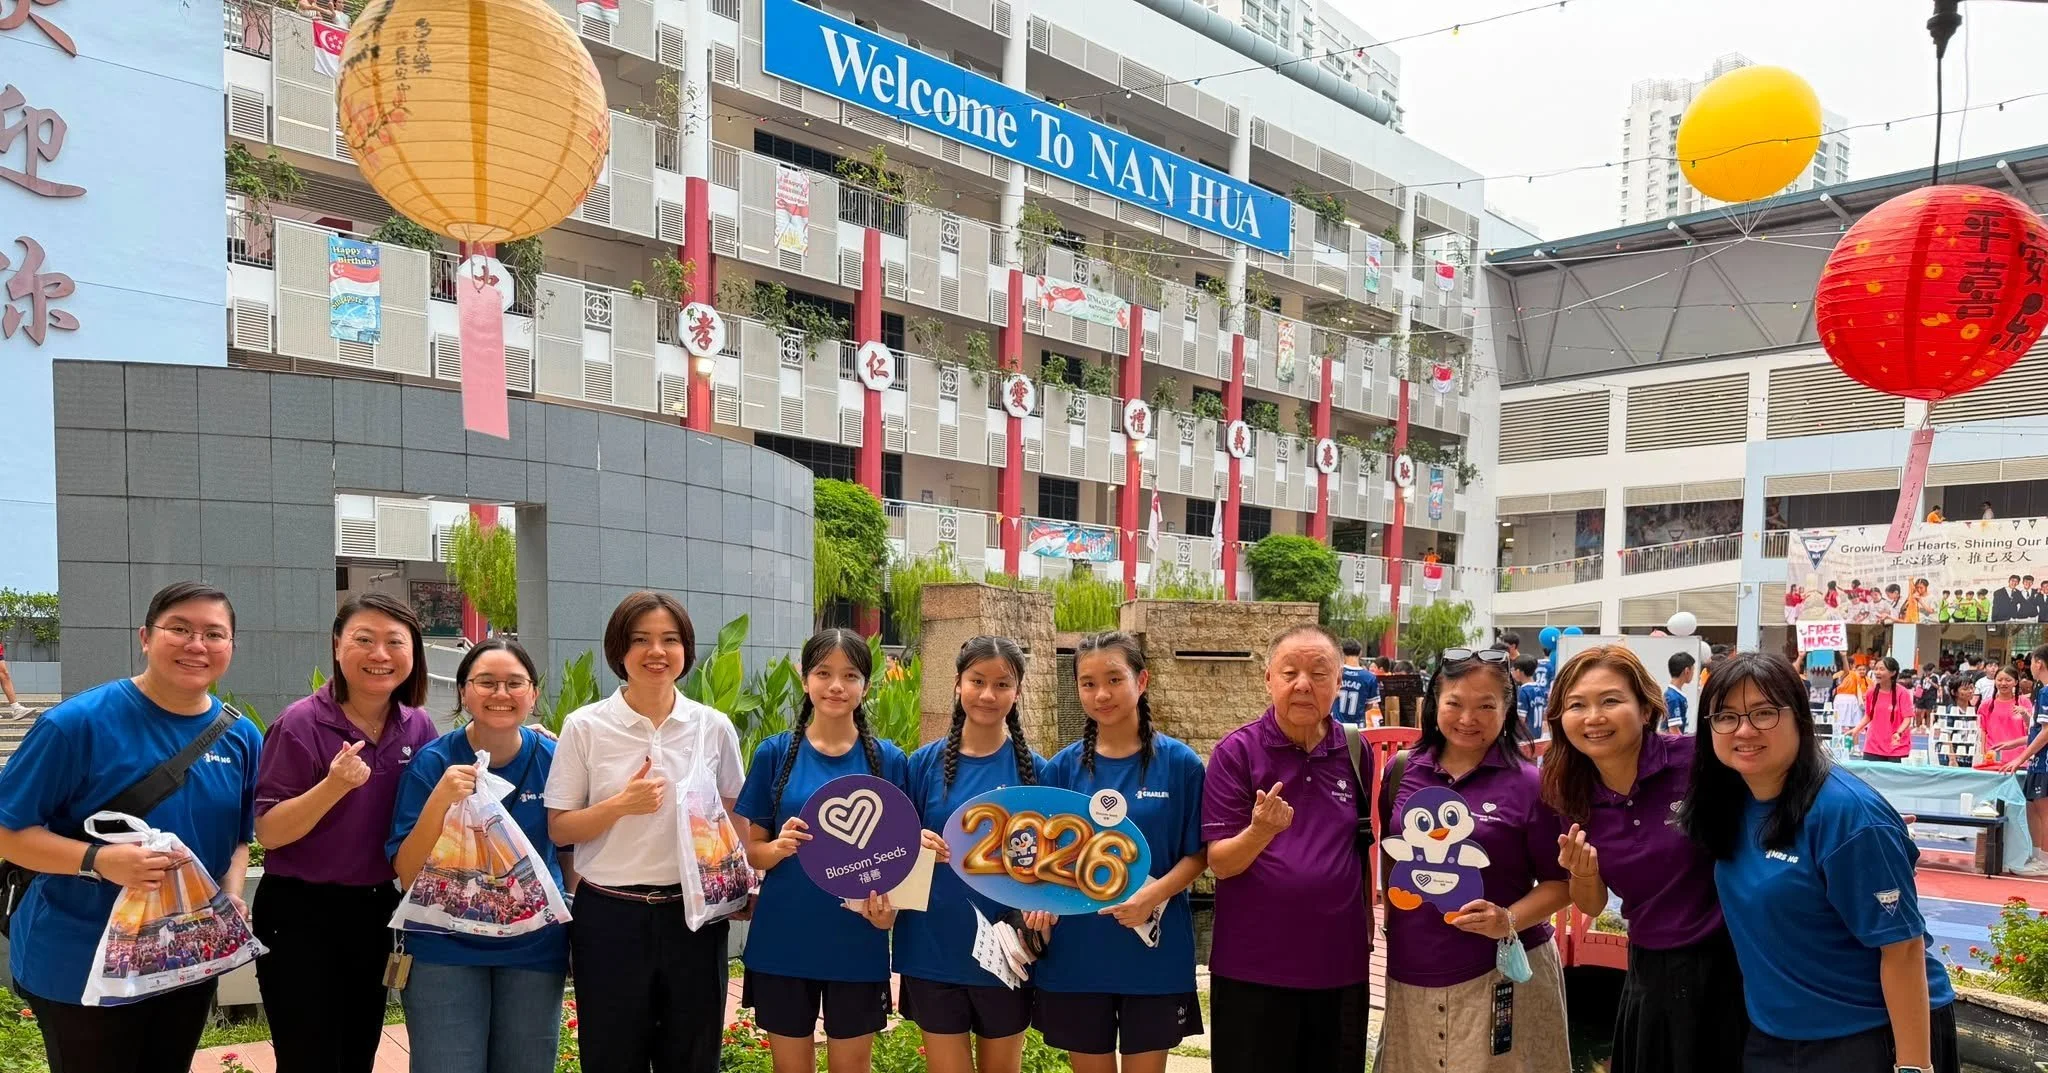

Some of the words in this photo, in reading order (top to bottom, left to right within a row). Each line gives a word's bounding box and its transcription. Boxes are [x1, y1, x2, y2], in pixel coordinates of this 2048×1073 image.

[818, 25, 1018, 148] Welcome
[1031, 108, 1075, 169] To
[1087, 131, 1178, 208] NAN
[1187, 171, 1262, 239] HUA
[332, 245, 361, 255] Happy
[337, 256, 377, 267] Birthday
[689, 310, 717, 350] 孝
[866, 350, 890, 380] 仁
[1009, 379, 1029, 412] 愛
[1130, 407, 1146, 434] 禮
[1917, 541, 1960, 551] Hearts,
[1964, 538, 2013, 550] Shining
[2017, 537, 2042, 547] Our
[1807, 624, 1841, 635] FREE
[1339, 690, 1359, 715] 11
[825, 858, 873, 880] Blossom
[873, 846, 907, 865] Seeds
[961, 802, 1138, 901] 2026
[1787, 855, 1799, 864] NG
